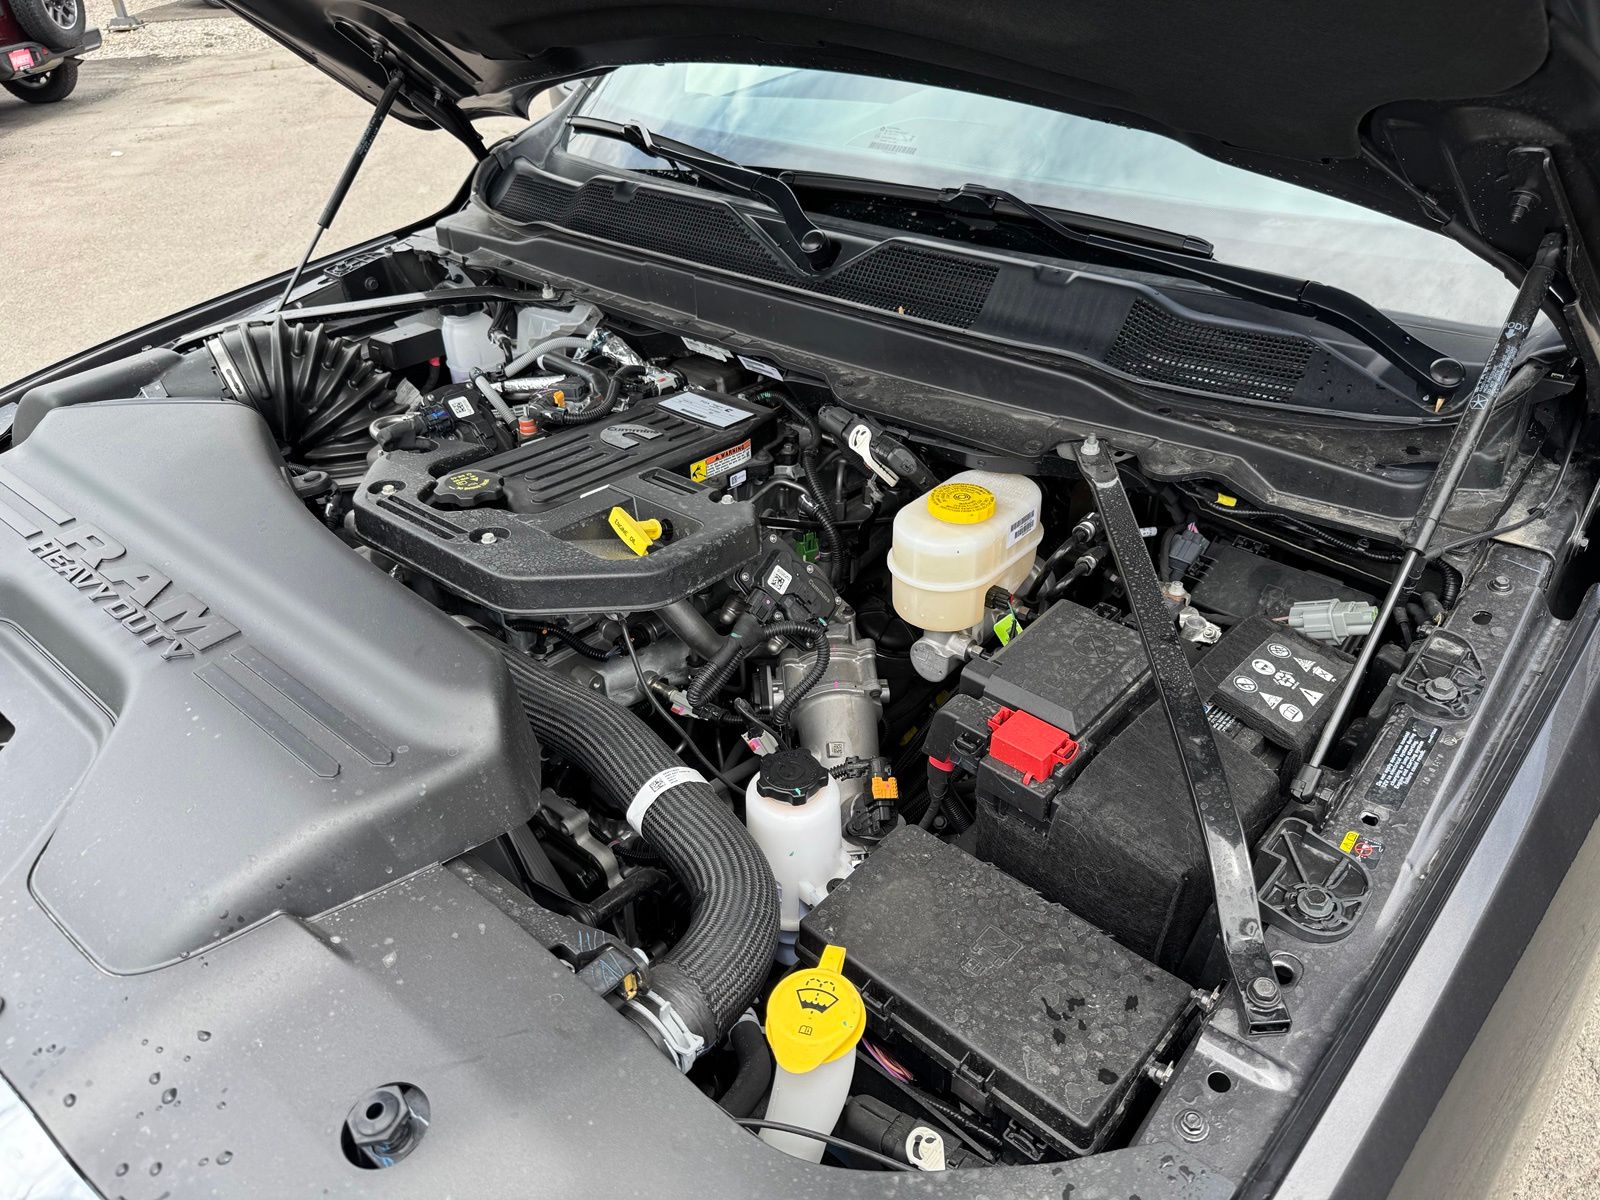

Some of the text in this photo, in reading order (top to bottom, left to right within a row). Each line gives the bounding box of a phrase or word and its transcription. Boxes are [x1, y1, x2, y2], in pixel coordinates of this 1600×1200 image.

[614, 518, 637, 546] ENGINE OIL
[28, 539, 195, 661] HEAVY DUTY
[53, 521, 242, 652] RAM
[808, 579, 831, 603] Cummins
